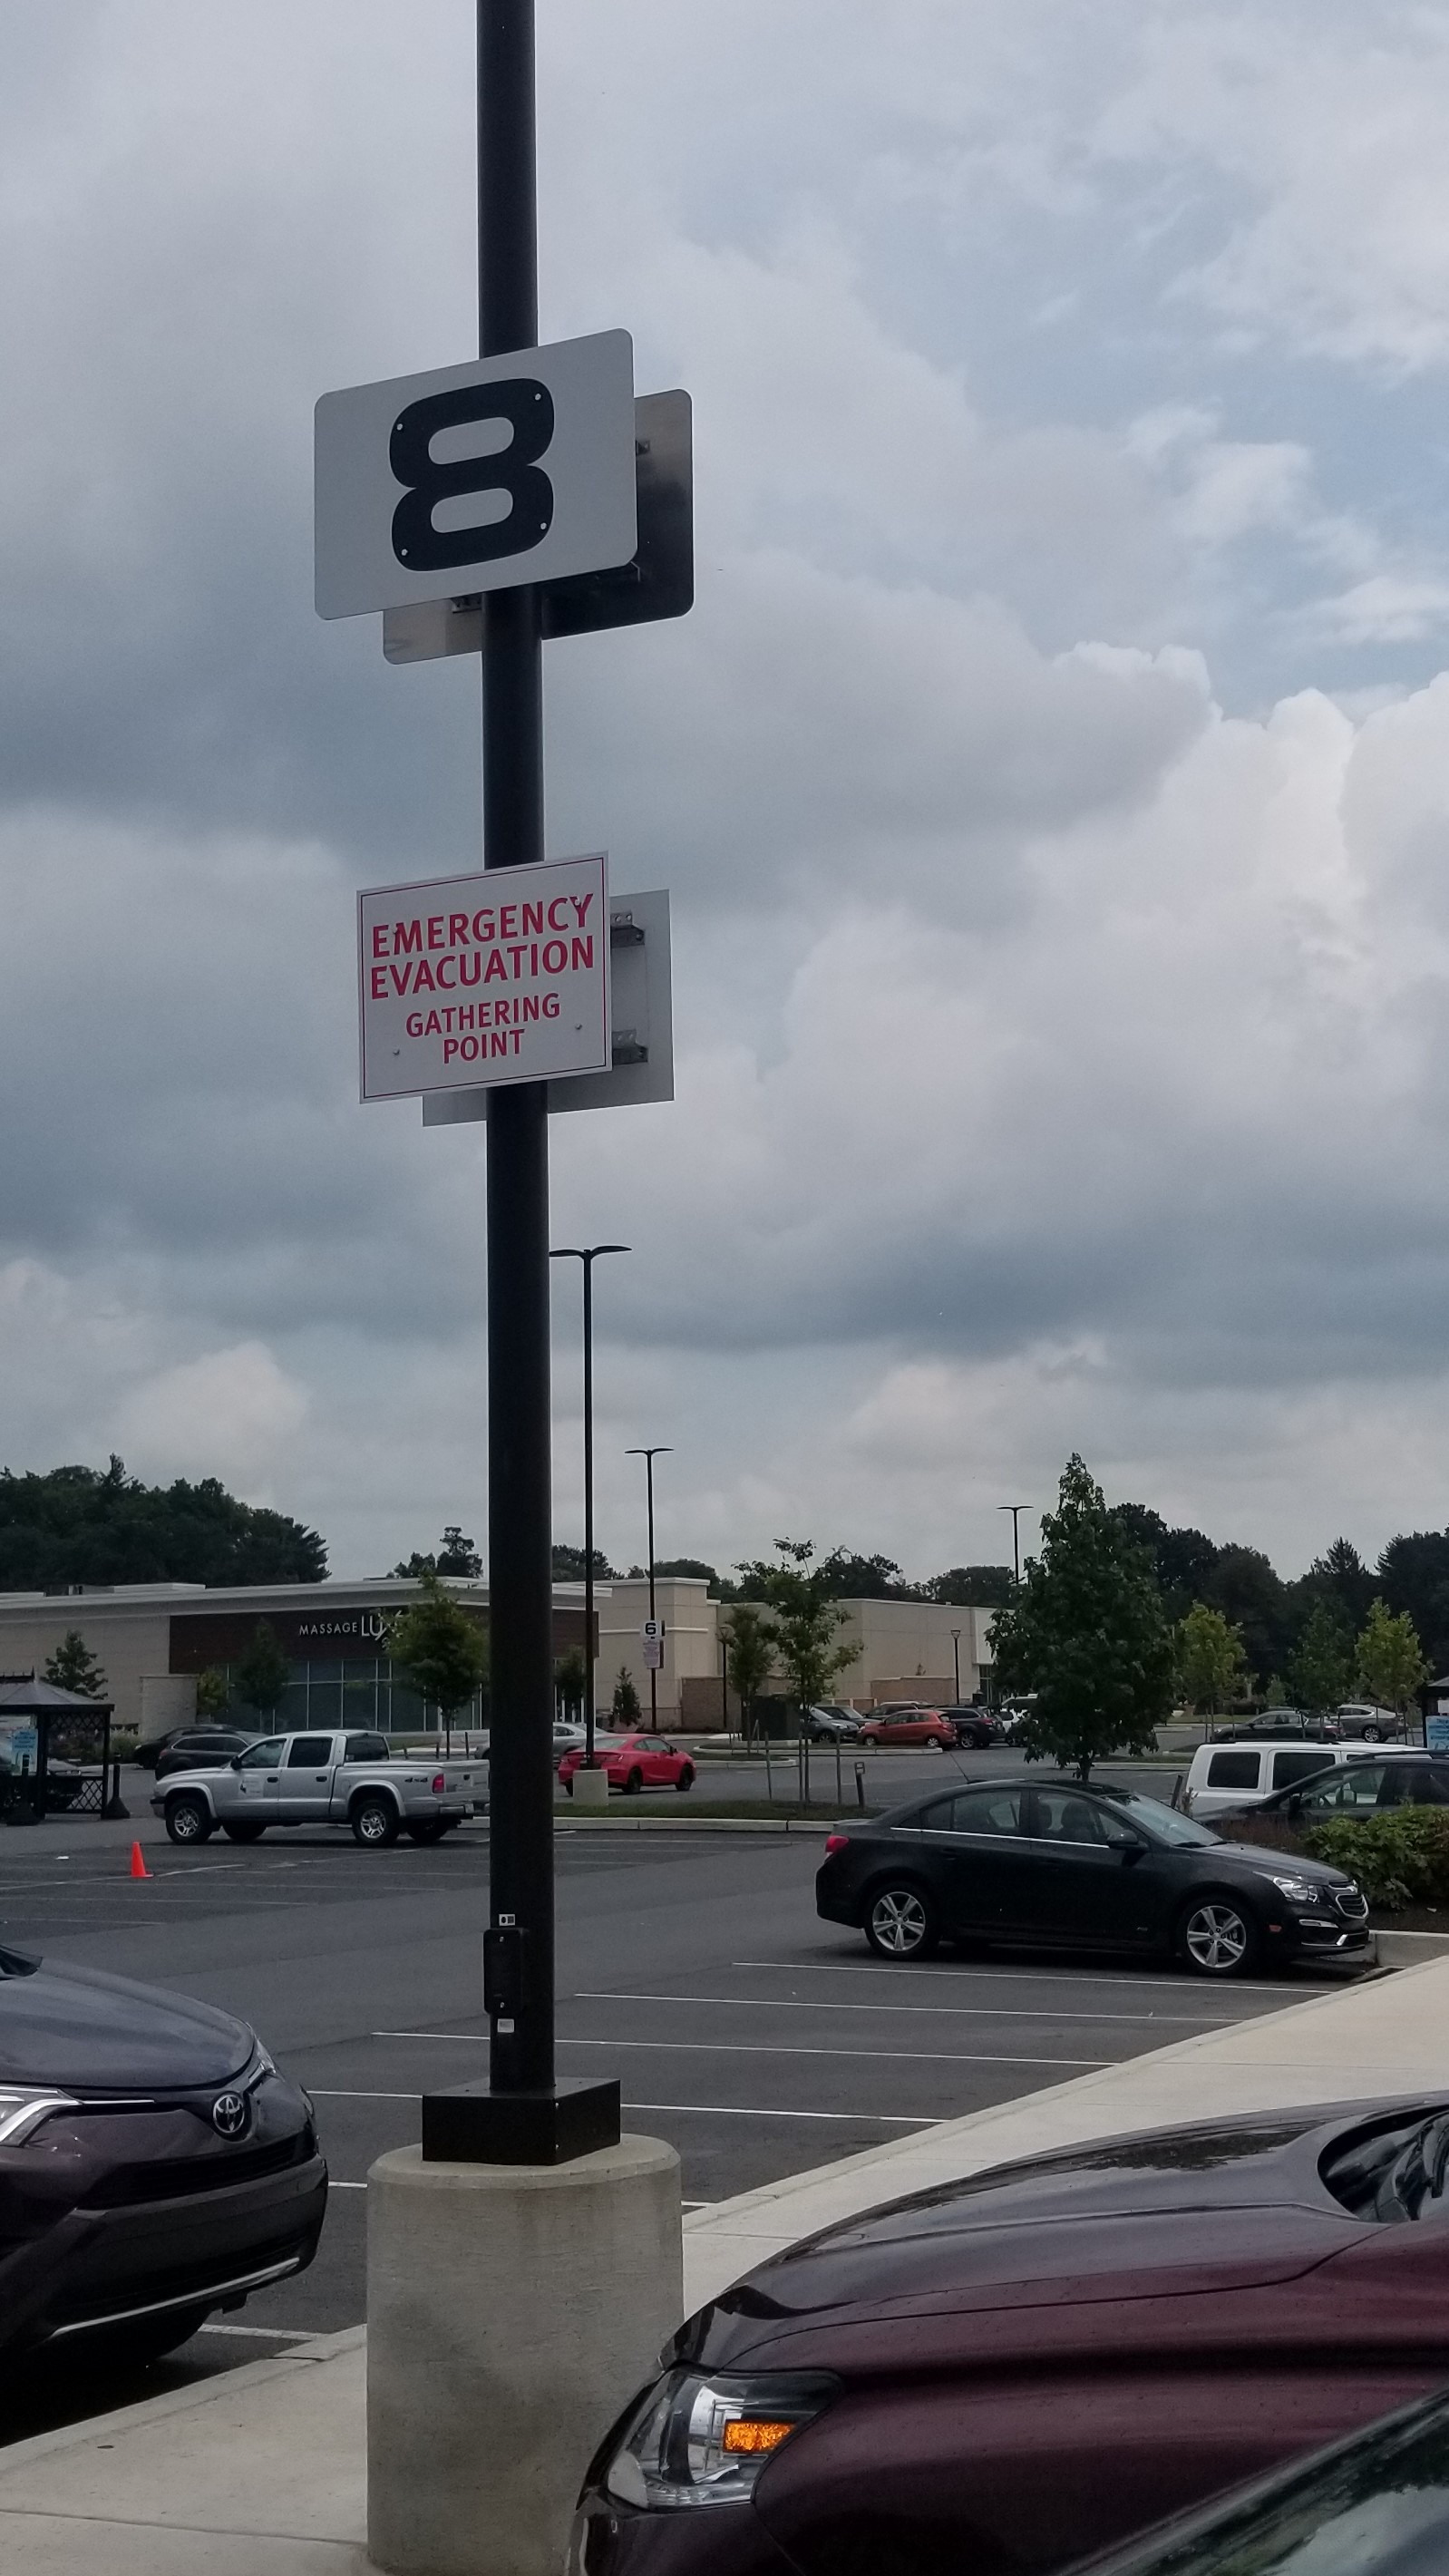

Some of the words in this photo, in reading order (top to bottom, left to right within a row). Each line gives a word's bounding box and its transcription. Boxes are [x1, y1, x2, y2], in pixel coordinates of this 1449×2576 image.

[389, 377, 555, 572] 8
[372, 893, 594, 958] EMERGENCY
[370, 935, 594, 1000] EVACUATION
[405, 992, 560, 1038] GATHERING
[442, 1028, 525, 1064] POINT
[298, 1621, 358, 1636] MASSAGE
[645, 1622, 656, 1636] 6
